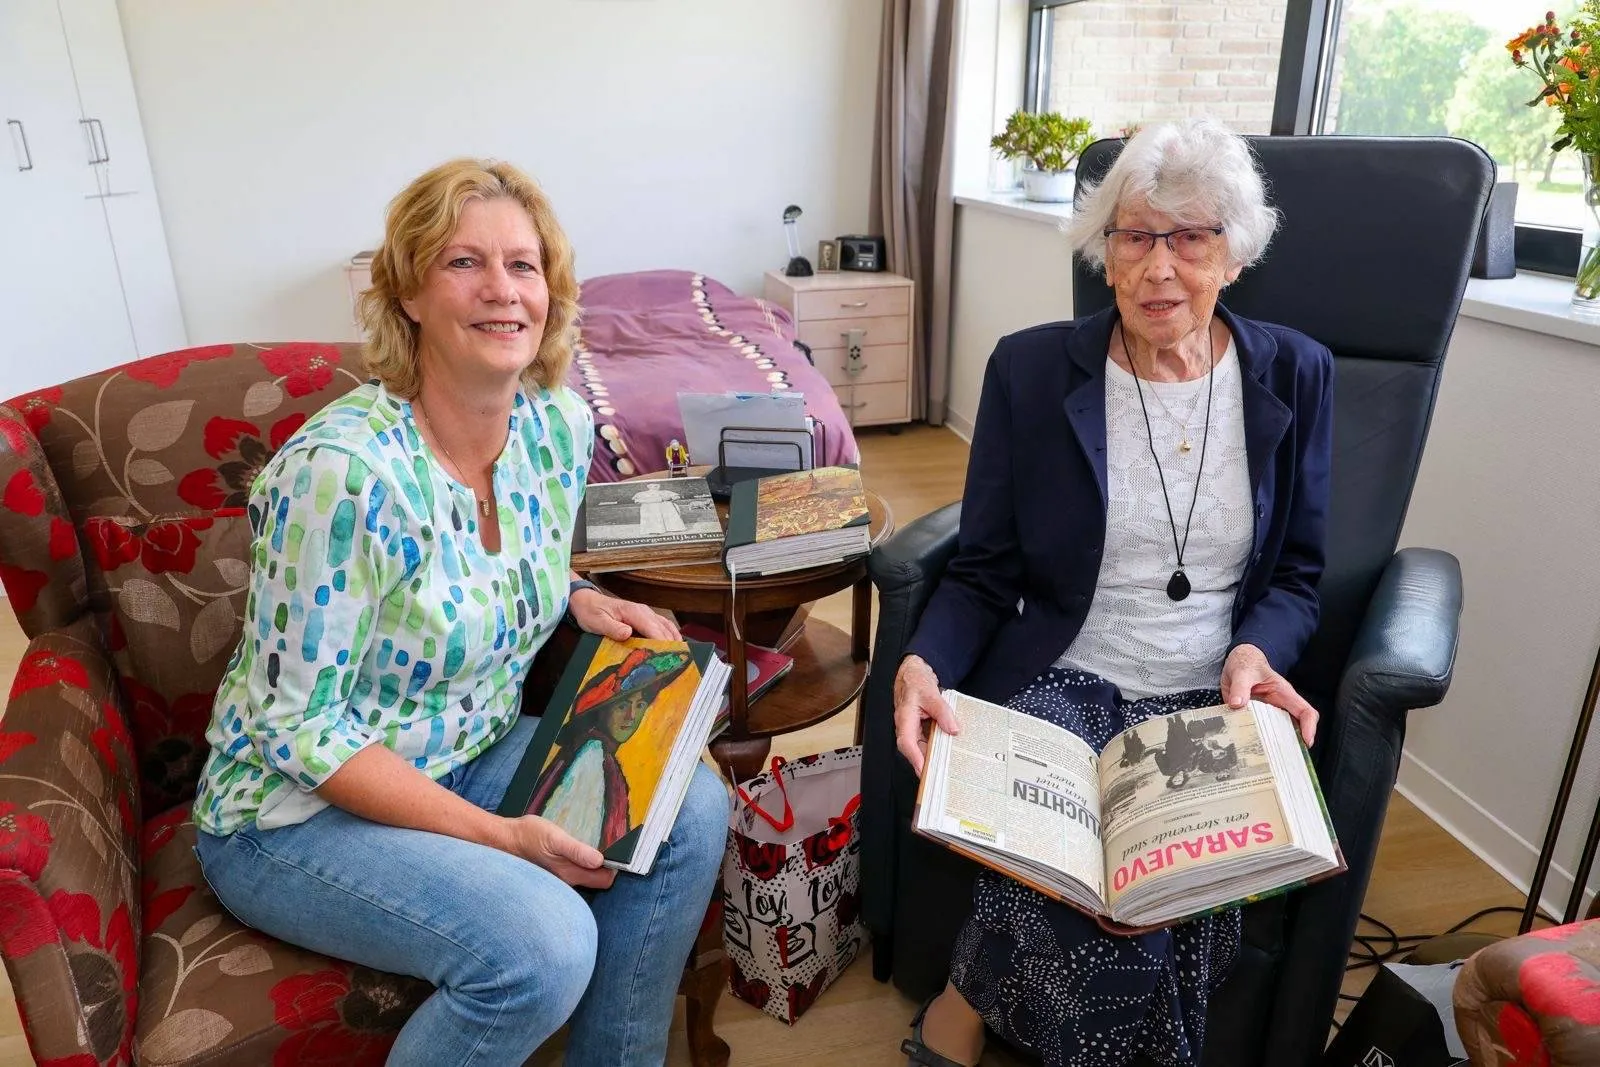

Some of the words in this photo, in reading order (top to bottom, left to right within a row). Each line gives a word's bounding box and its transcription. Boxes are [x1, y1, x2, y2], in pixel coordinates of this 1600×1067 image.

[597, 540, 619, 548] Een
[620, 534, 698, 547] onvergetelijke
[1225, 812, 1250, 824] een
[1151, 817, 1220, 844] stervende
[1113, 822, 1274, 892] SARAJEVO
[1122, 839, 1148, 861] stad
[742, 878, 788, 927] Lov
